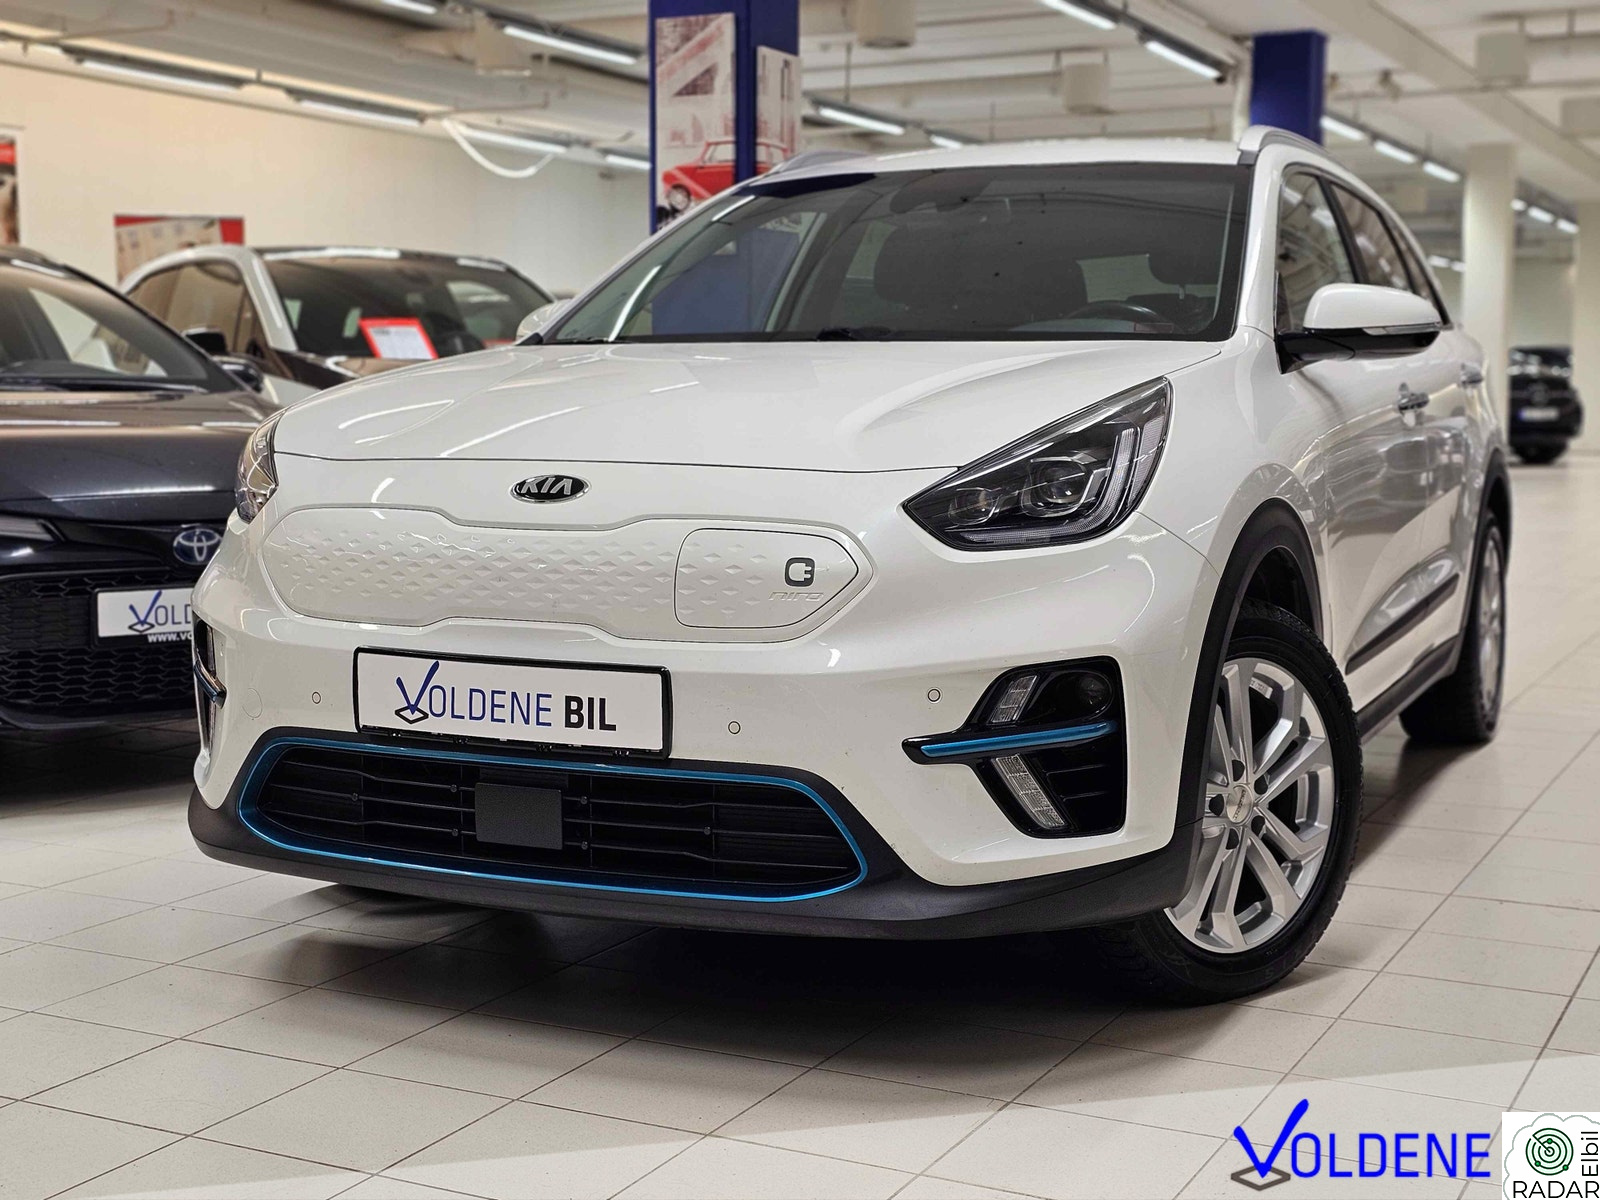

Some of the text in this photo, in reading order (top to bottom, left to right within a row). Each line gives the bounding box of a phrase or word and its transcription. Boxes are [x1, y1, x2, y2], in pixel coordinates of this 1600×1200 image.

[520, 476, 573, 495] KIA
[396, 660, 617, 731] VOLDENE BIL
